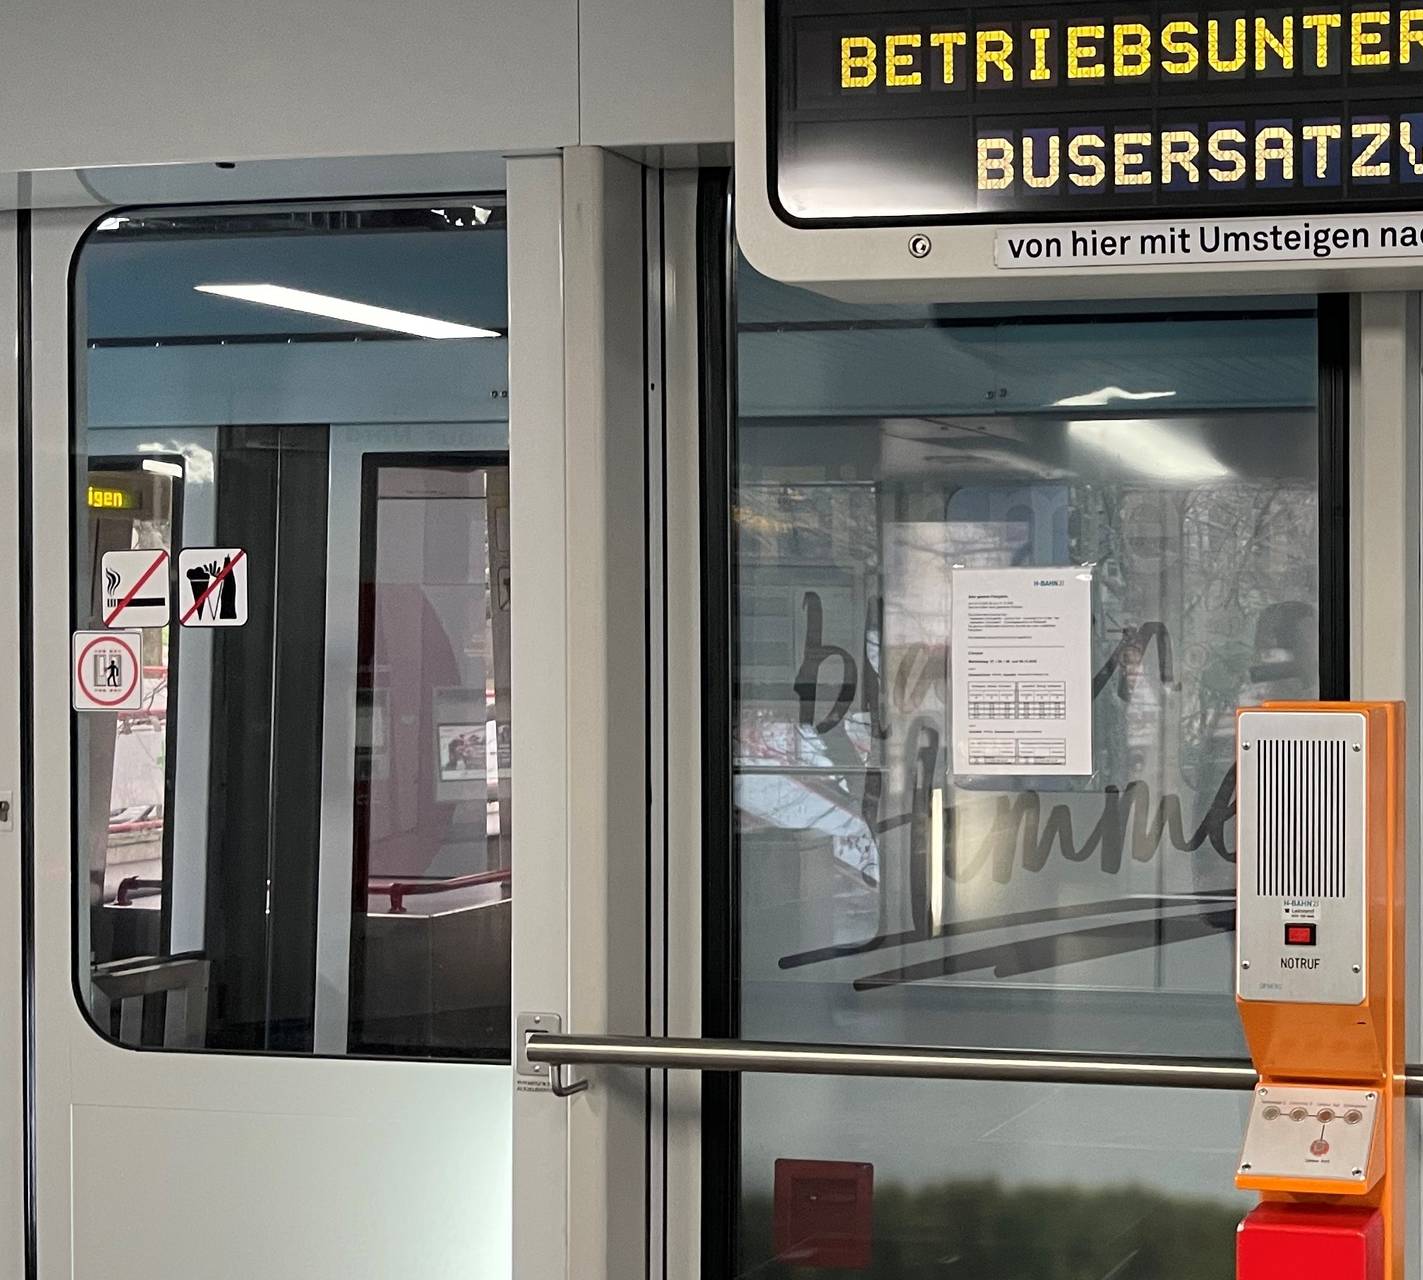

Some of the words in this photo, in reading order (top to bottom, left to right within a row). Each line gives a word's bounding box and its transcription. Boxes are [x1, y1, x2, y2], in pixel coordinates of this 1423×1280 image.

[1008, 238, 1062, 259] von
[1072, 230, 1131, 257] hier
[1140, 228, 1191, 255] mit
[1199, 222, 1369, 257] Umsteigen
[87, 487, 123, 507] igen
[1280, 957, 1321, 970] NOTRUF
